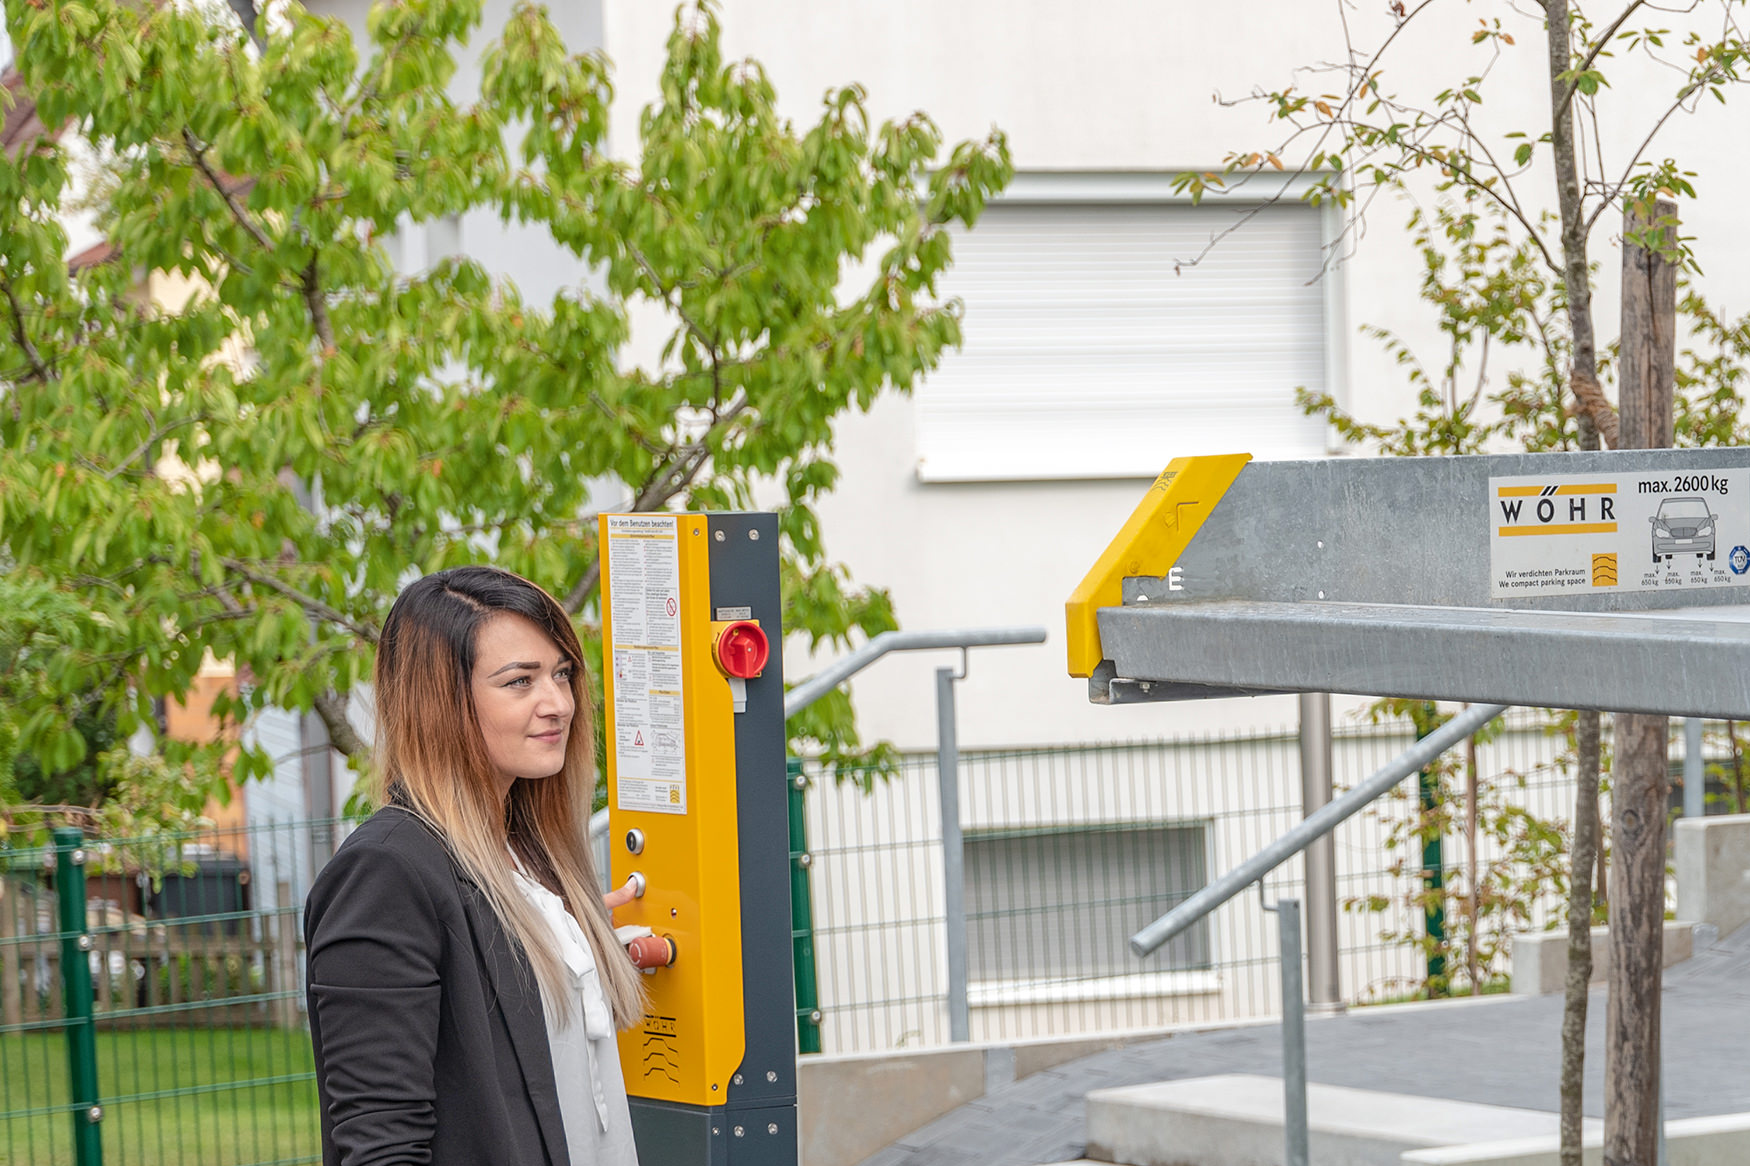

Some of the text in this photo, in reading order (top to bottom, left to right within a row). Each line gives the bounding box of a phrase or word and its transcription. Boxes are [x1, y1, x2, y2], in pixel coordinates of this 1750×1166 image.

[1638, 474, 1729, 495] max. 2600 kg
[1500, 485, 1616, 524] WÖHR
[1505, 568, 1586, 578] Wir verdichten Parkraum
[1498, 578, 1586, 588] We compact parking space
